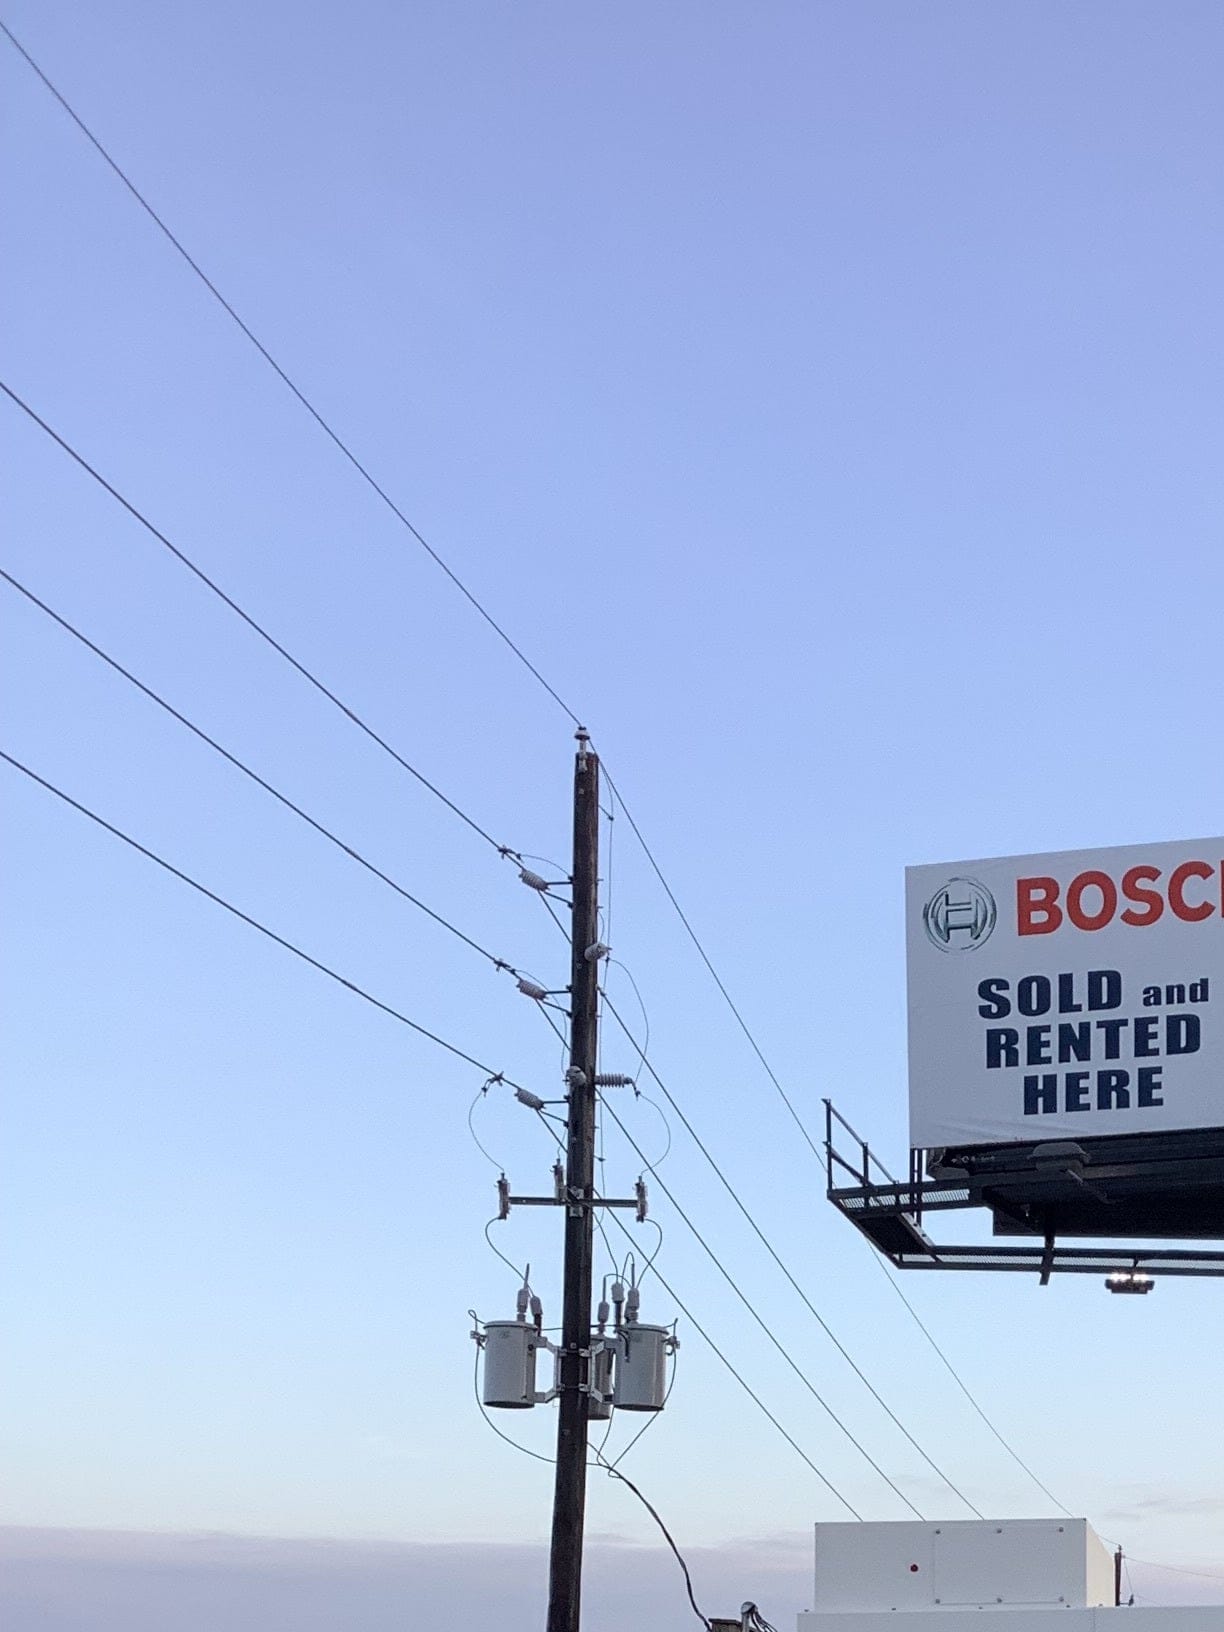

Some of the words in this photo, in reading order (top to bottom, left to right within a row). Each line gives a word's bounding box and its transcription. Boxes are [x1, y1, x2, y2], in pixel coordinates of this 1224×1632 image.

[977, 970, 1122, 1019] SOLD
[1142, 977, 1209, 1007] and
[986, 1013, 1200, 1069] RENTED
[1023, 1066, 1164, 1115] HERE
